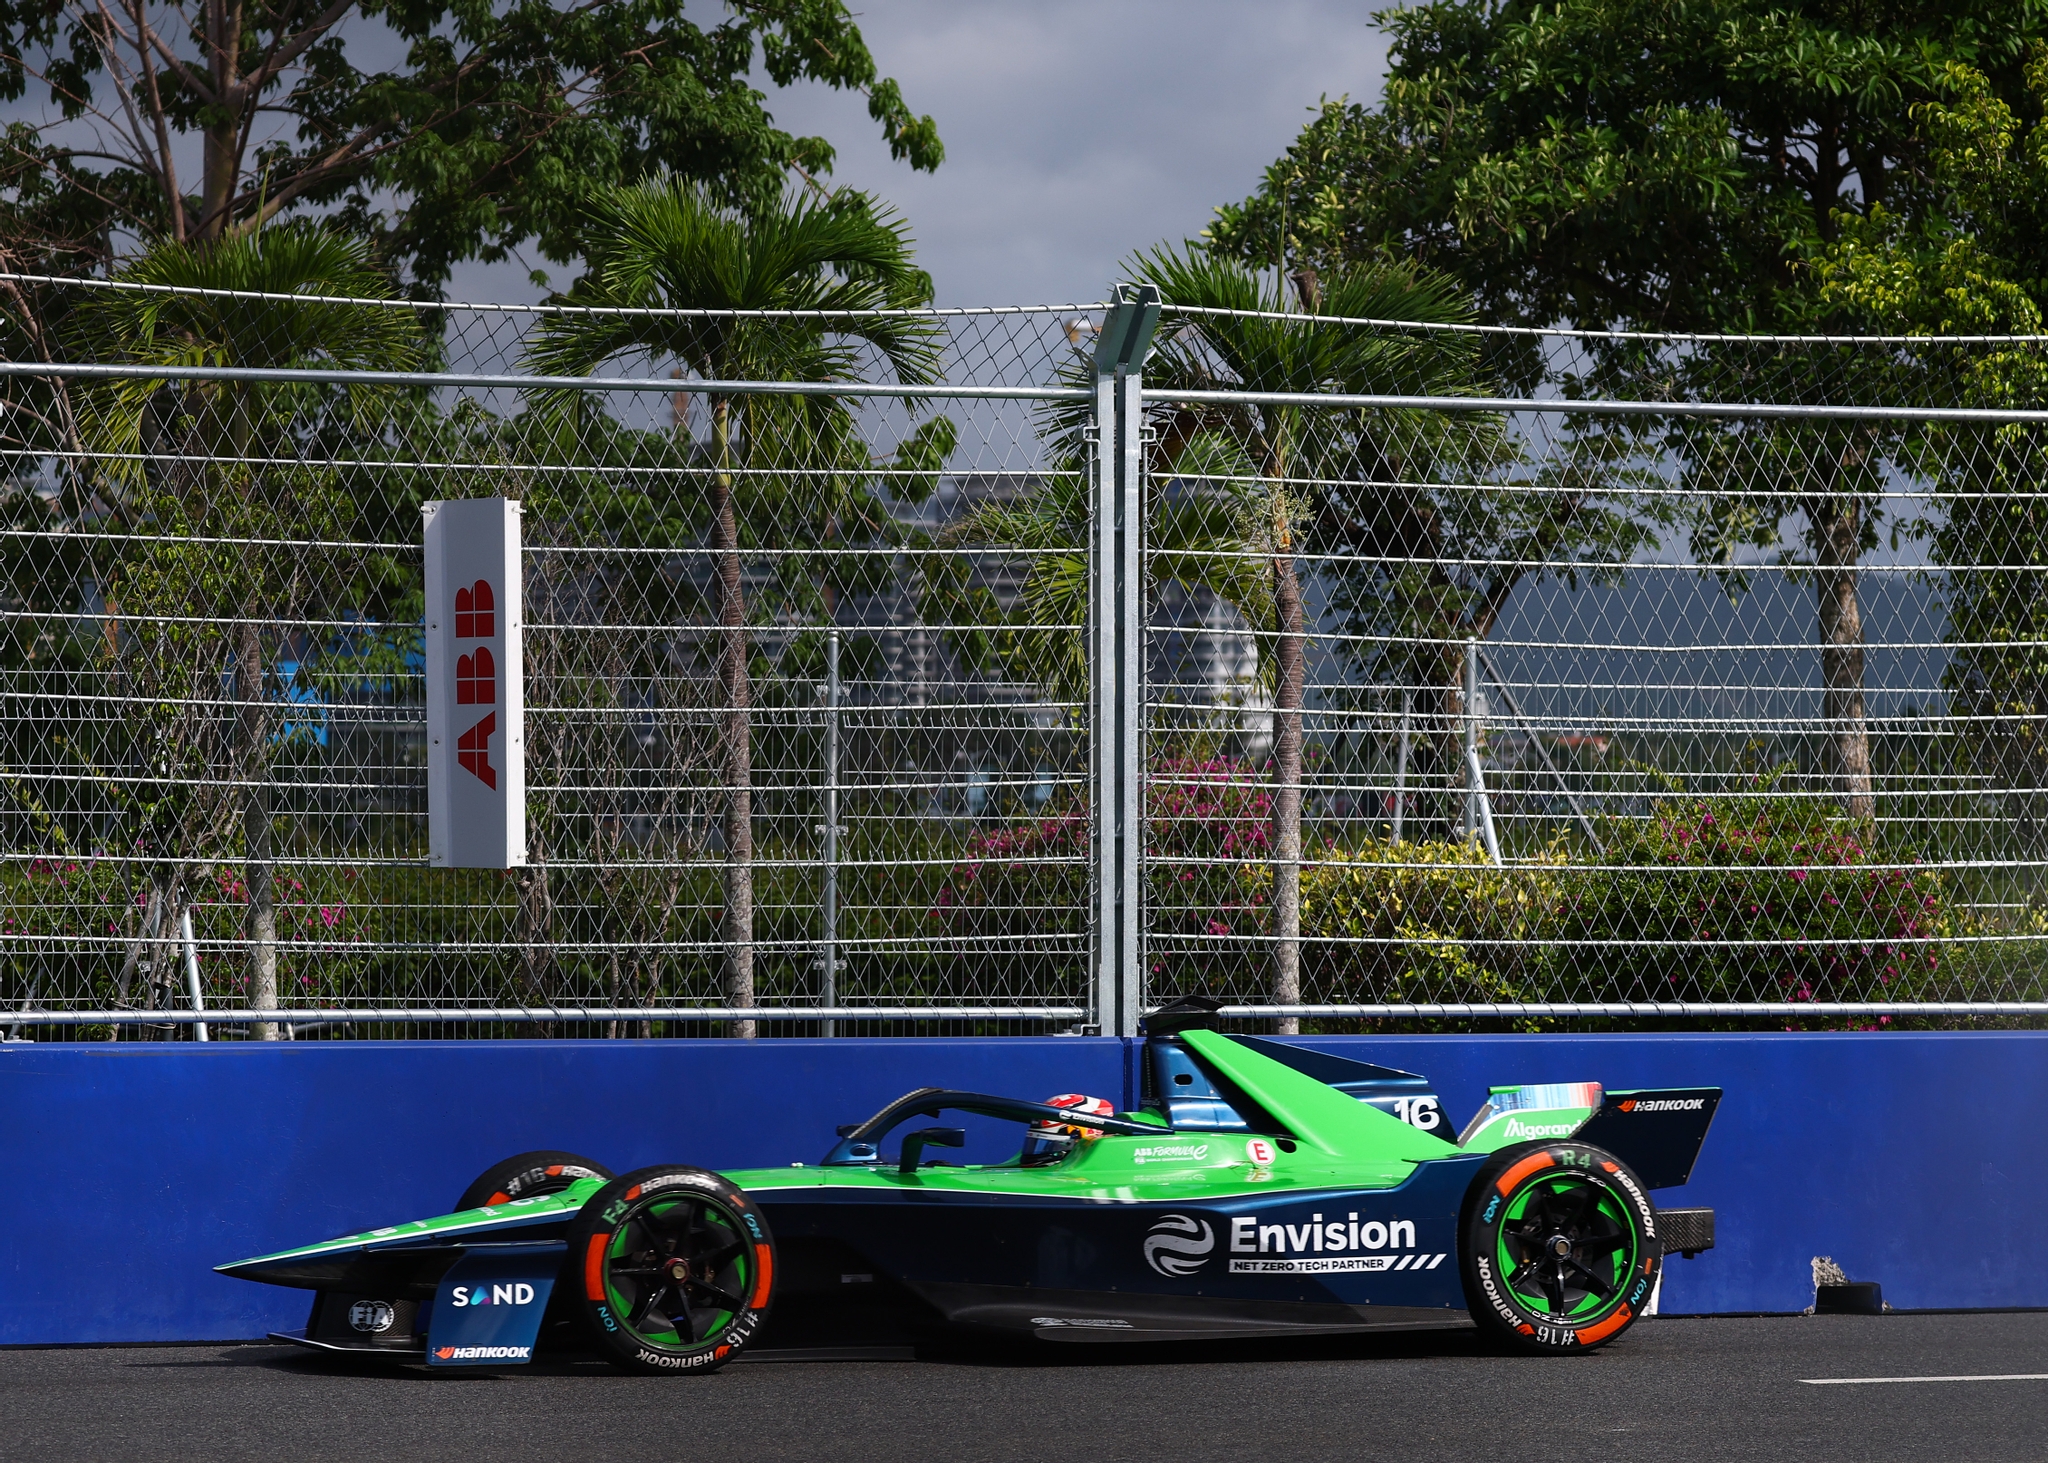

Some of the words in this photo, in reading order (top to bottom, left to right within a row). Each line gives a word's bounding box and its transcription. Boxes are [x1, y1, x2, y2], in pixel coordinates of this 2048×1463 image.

[455, 579, 496, 791] ABB
[1394, 1098, 1440, 1130] 16
[1134, 1148, 1152, 1156] ABB
[1152, 1145, 1194, 1156] FORMULA
[1253, 1143, 1268, 1160] E
[1230, 1212, 1416, 1252] Envision
[1234, 1261, 1260, 1271] NET
[1261, 1261, 1295, 1271] ZERO
[1297, 1261, 1329, 1271] TECH
[1332, 1259, 1385, 1270] PARTNER
[726, 1311, 758, 1347] #16
[1536, 1326, 1575, 1346] #16
